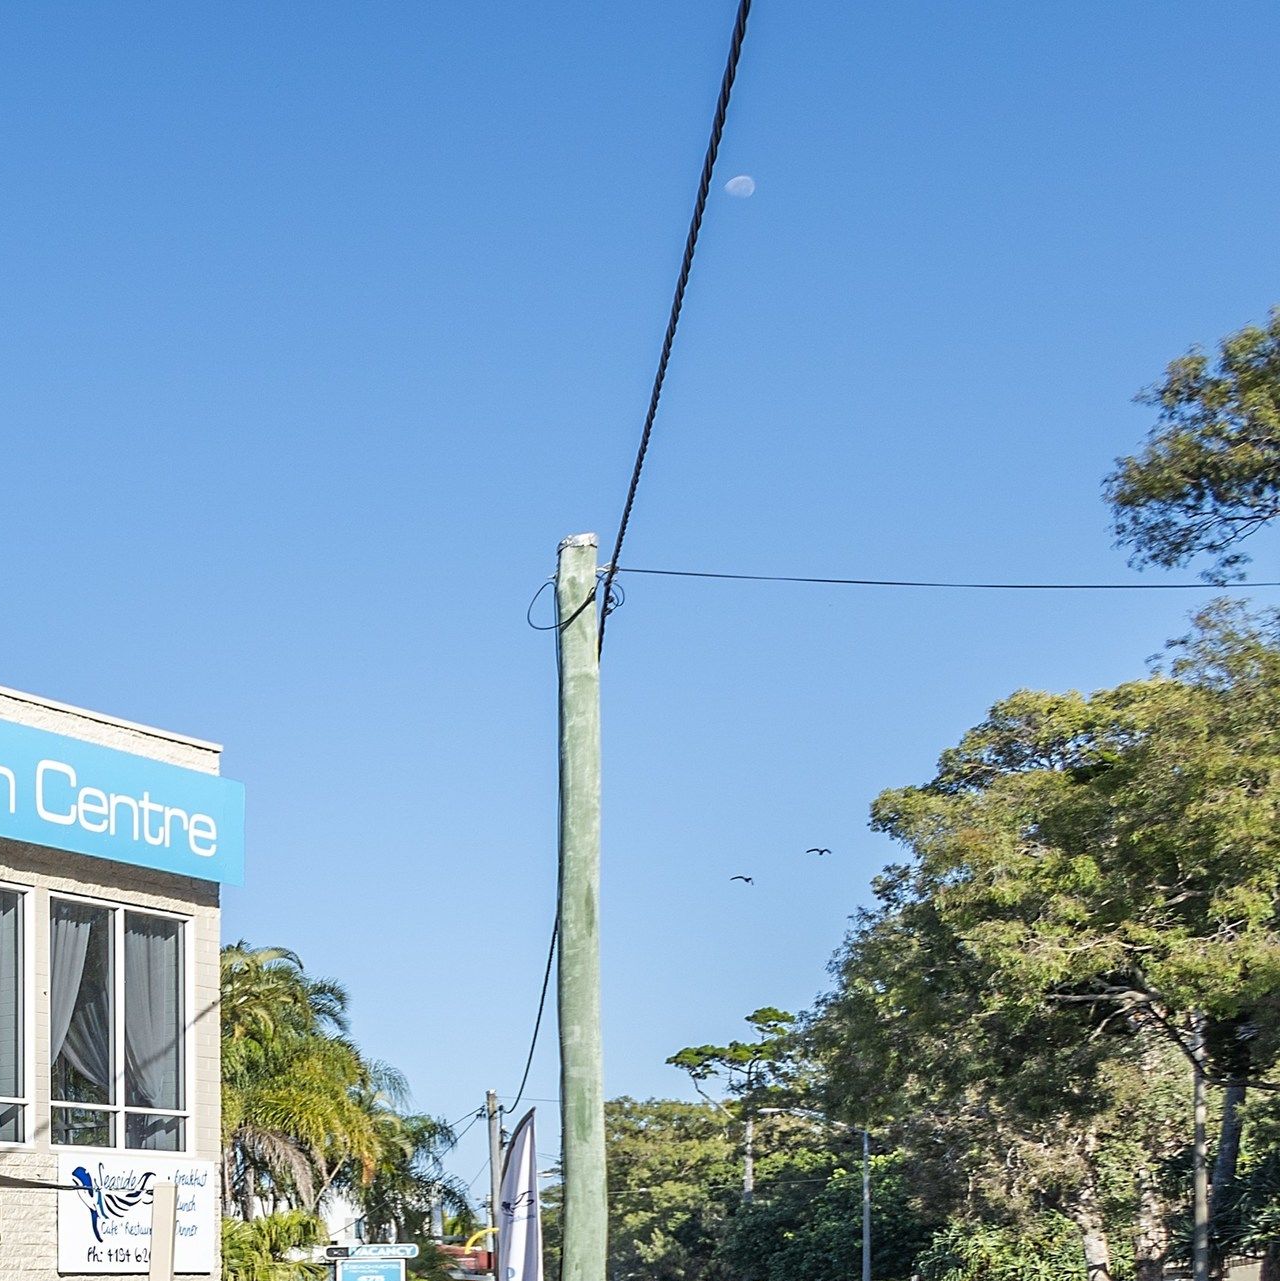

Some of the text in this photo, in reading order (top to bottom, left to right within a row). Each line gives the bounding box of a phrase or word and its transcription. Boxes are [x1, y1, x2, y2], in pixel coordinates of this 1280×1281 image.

[35, 758, 218, 858] Centre
[94, 1162, 138, 1190] Seaside
[107, 1248, 131, 1262] 4194
[135, 1247, 151, 1262] 62
